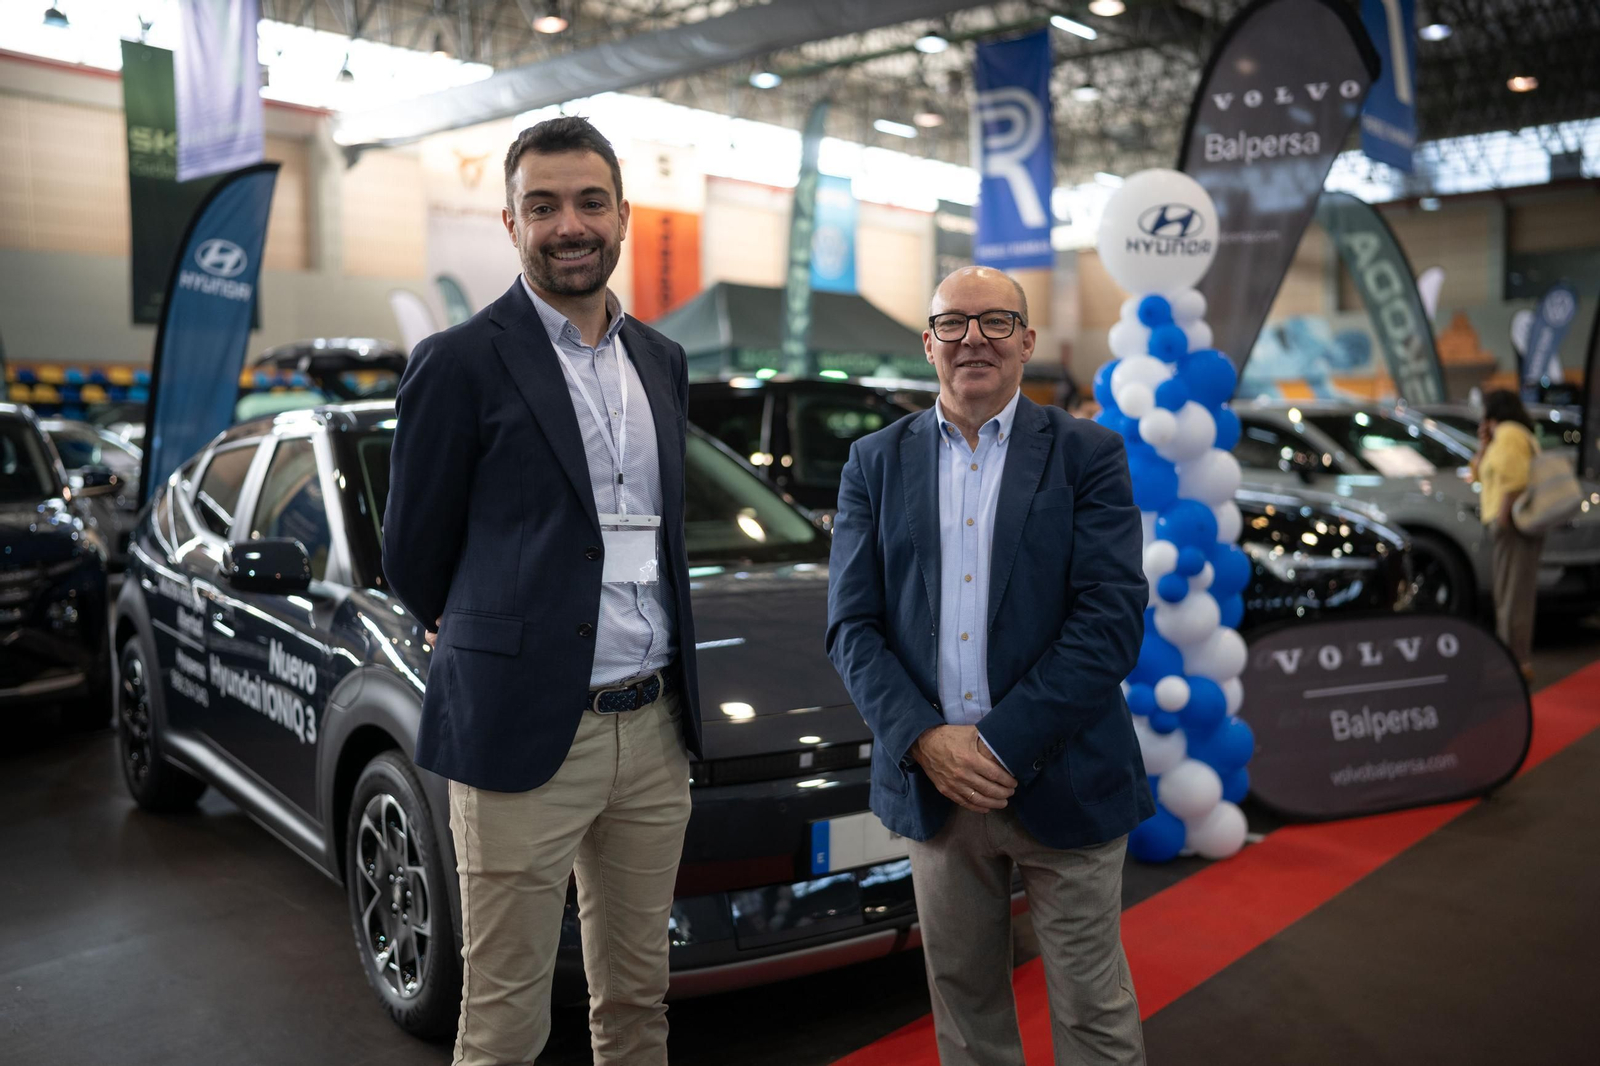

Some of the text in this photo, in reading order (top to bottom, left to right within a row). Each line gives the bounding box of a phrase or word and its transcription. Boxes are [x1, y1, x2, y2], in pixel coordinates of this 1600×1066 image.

[1212, 80, 1361, 111] VOLVO
[1204, 130, 1321, 164] Balpersa
[269, 638, 317, 695] Nuevo
[1272, 633, 1460, 675] VOLVO
[209, 653, 261, 712] Hyundai
[261, 680, 306, 743] IONIQ
[305, 705, 317, 744] 3
[1330, 705, 1438, 743] Balpersa
